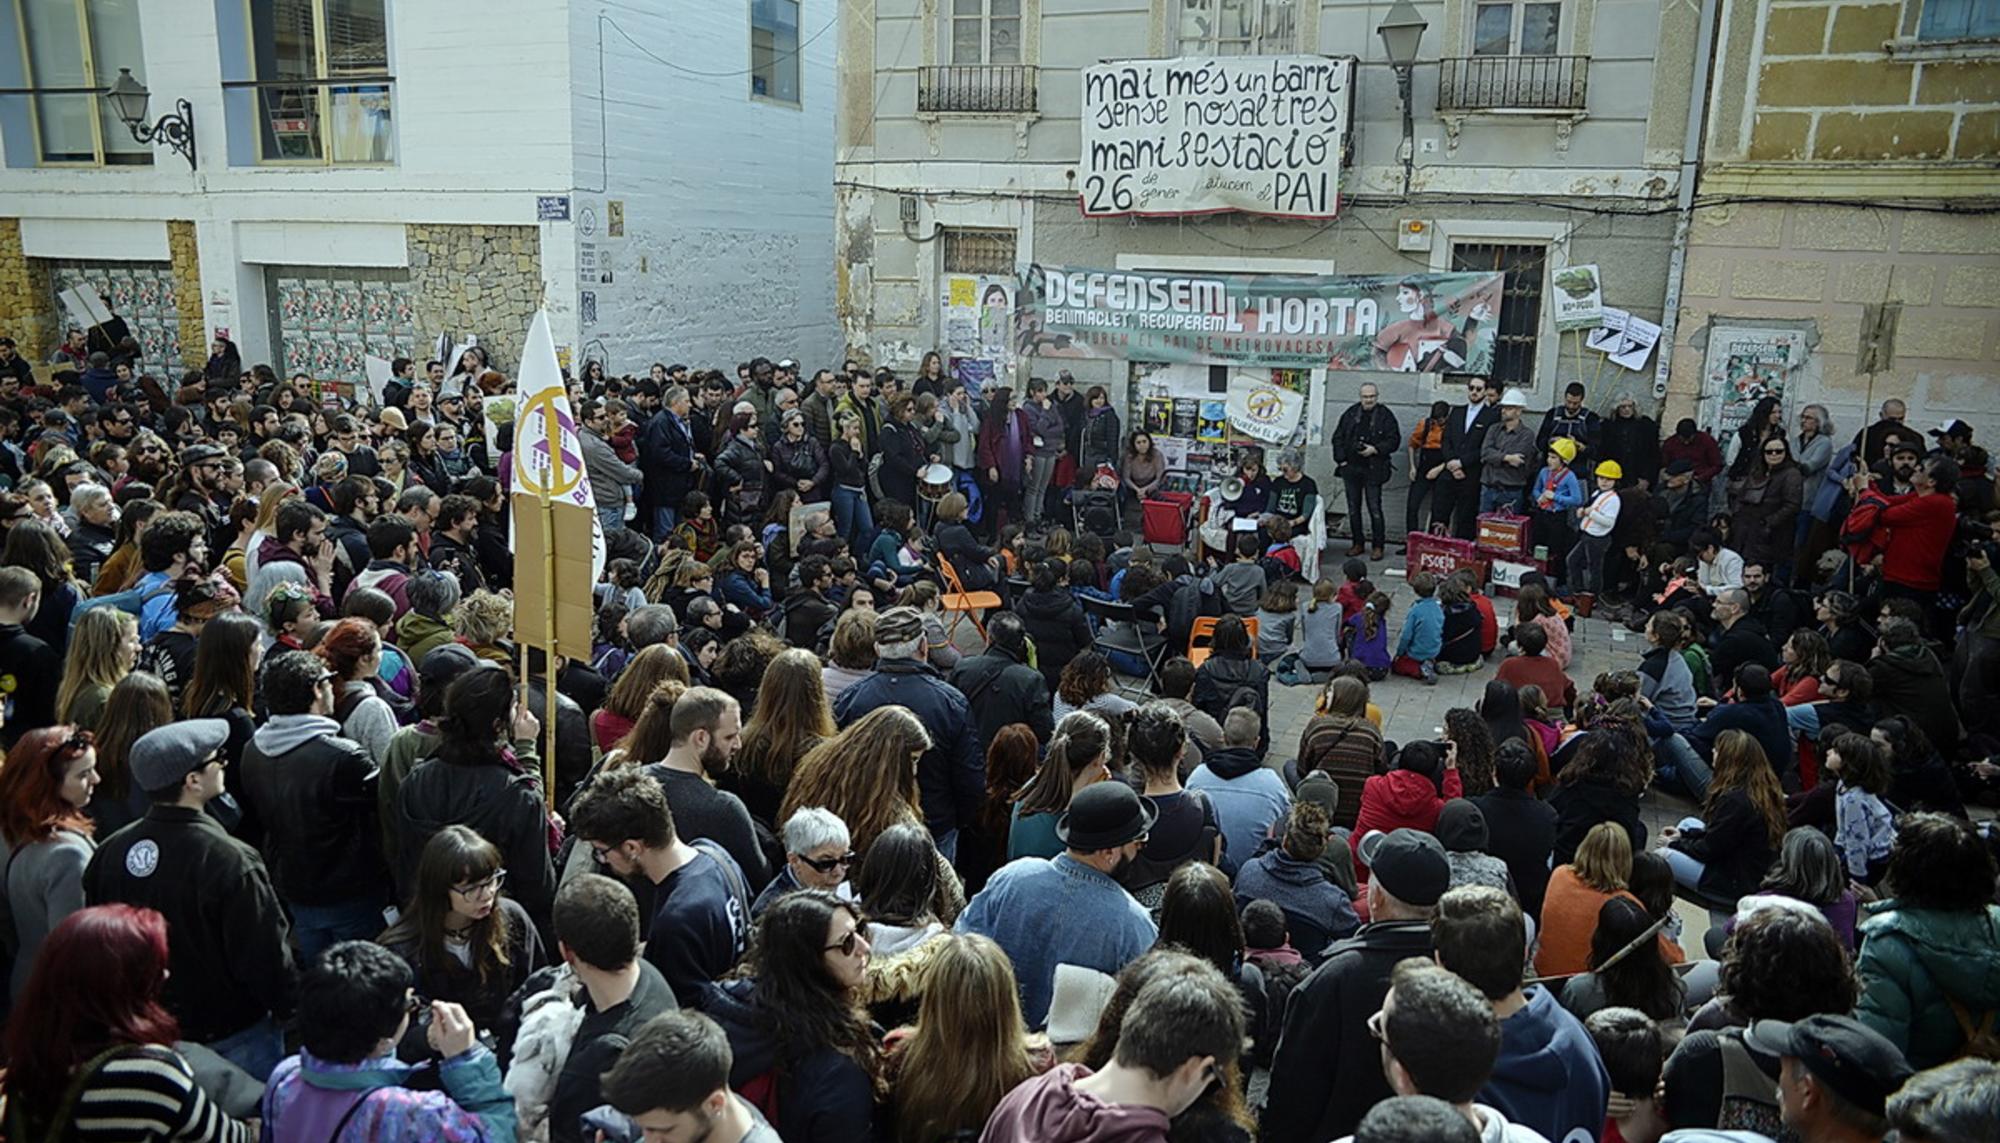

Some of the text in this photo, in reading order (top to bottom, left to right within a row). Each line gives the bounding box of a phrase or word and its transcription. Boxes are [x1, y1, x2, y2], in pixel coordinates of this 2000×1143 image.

[1086, 60, 1340, 106] mai més un barri
[1096, 93, 1337, 130] sense nosaltres
[1085, 172, 1327, 212] 26 PAI
[1142, 172, 1158, 185] de
[1140, 188, 1180, 207] gener
[1044, 271, 1226, 314] DEFENSEM
[1045, 309, 1226, 332] BENIMACLET, RECUPEREM
[1226, 297, 1379, 336] L'HORTA
[1074, 330, 1335, 354] ATUREM EL PAI DE METROVACESA
